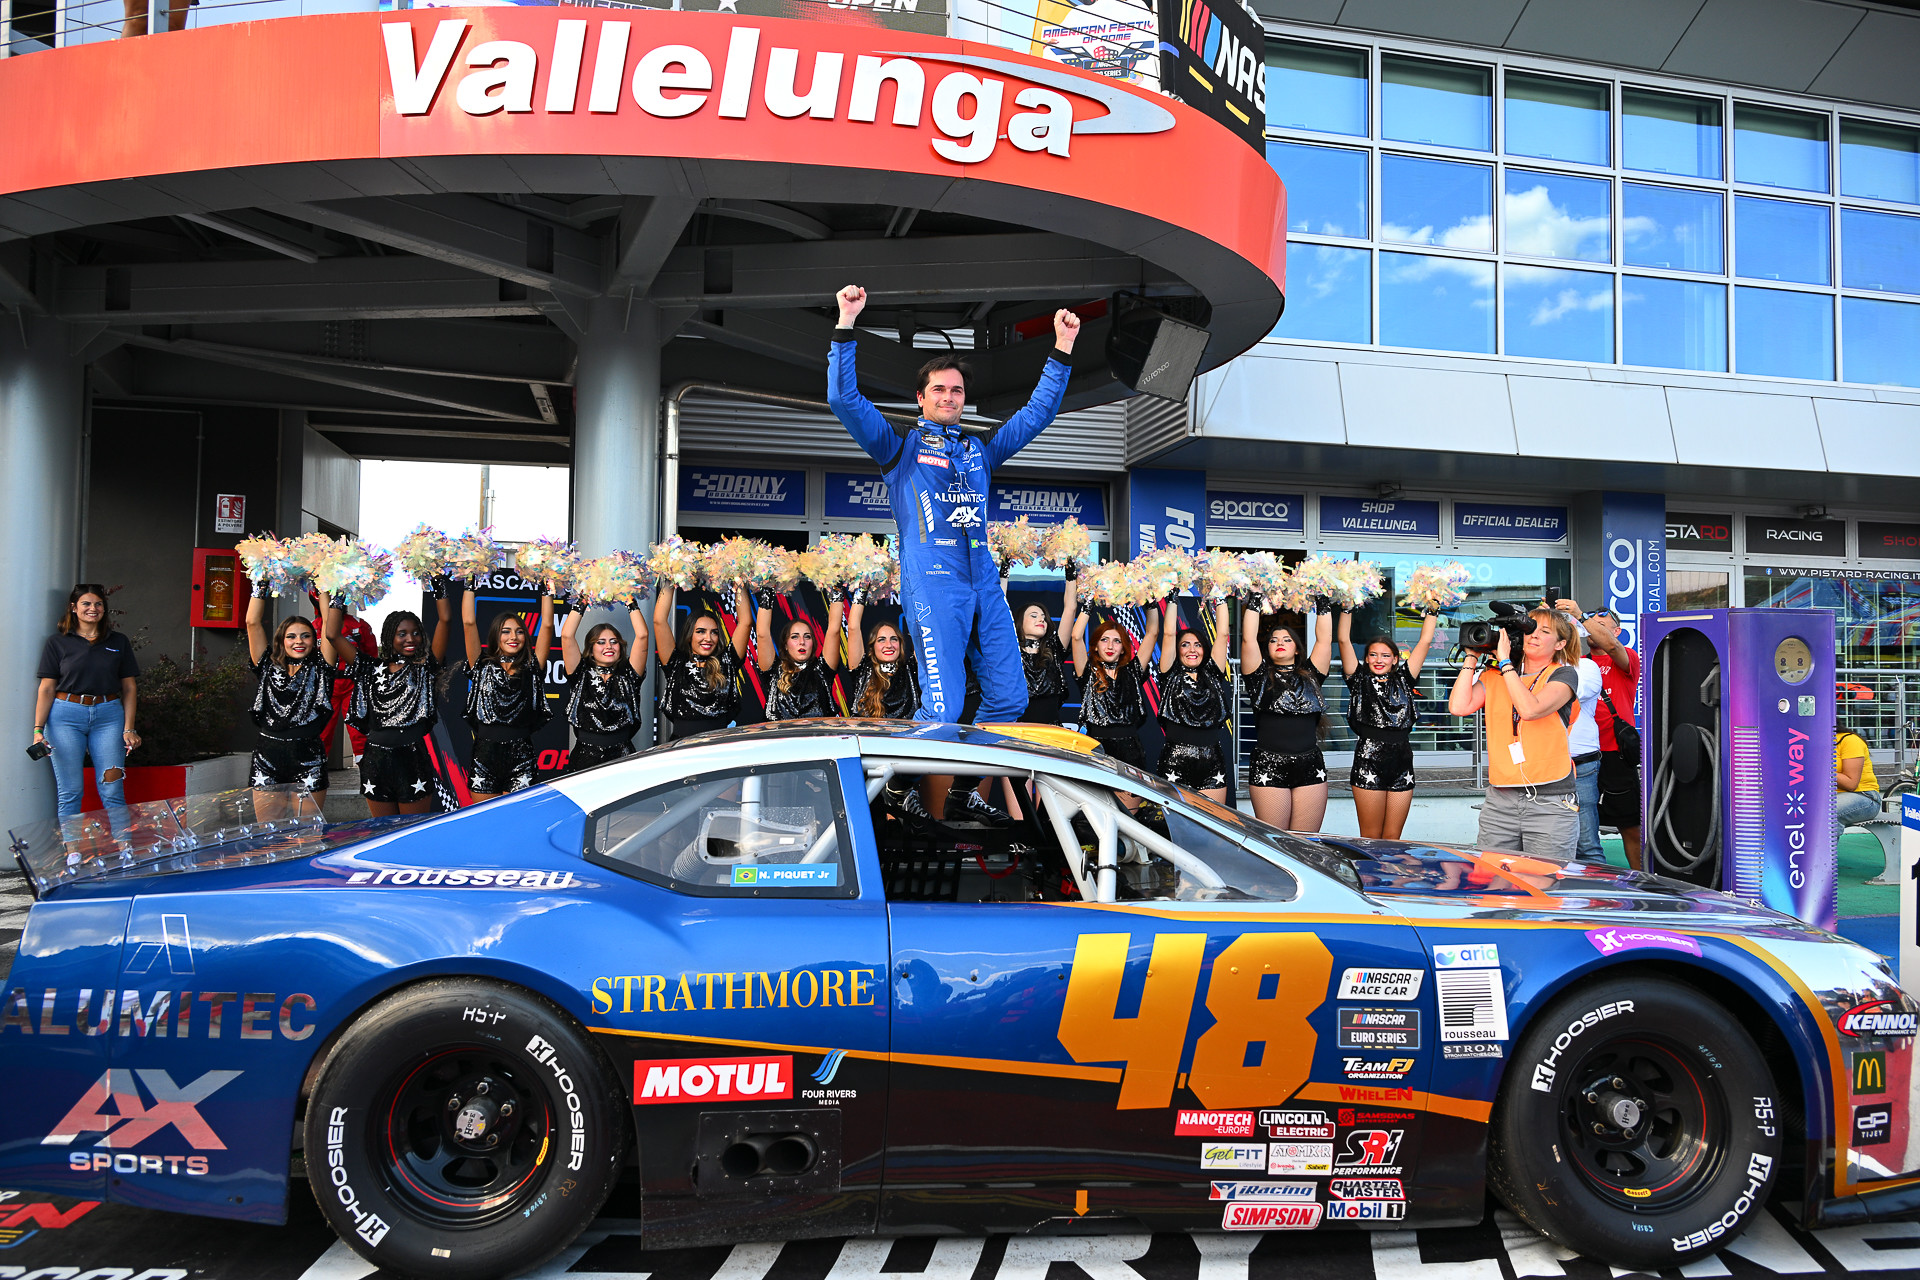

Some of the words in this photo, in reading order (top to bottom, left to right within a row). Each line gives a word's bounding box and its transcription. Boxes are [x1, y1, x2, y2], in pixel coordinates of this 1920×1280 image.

[1043, 25, 1106, 38] AMERICAN
[382, 18, 1074, 163] Vallelunga
[920, 456, 947, 467] MOTUL
[716, 475, 785, 493] DANY
[1020, 490, 1080, 508] DANY
[1210, 500, 1288, 520] sparco
[1361, 502, 1395, 513] SHOP
[1342, 517, 1417, 531] VALLELUNGA
[1462, 514, 1513, 527] OFFICIAL
[1515, 516, 1559, 528] DEALER
[1766, 529, 1823, 541] RACING
[1883, 535, 1920, 546] SHO
[1779, 568, 1920, 579] WWW.PISTARD-RACING.IT
[920, 626, 946, 713] ALUMITEC
[1788, 727, 1809, 786] way
[1785, 822, 1805, 889] enel
[373, 868, 574, 889] rousseau
[759, 871, 770, 879] N.
[773, 871, 815, 879] PIQUET
[817, 871, 830, 879] Jr
[1618, 933, 1693, 948] HOOSIER
[1460, 946, 1498, 961] aria
[1366, 972, 1412, 984] NASCAR
[591, 968, 875, 1014] STRATHMORE
[1350, 985, 1381, 995] RACE
[1384, 986, 1408, 995] CAR
[0, 987, 318, 1041] ALUMITEC
[1057, 932, 1334, 1110] 48
[1365, 1014, 1406, 1025] NASCAR
[1844, 1014, 1917, 1030] KENNOL
[1350, 1031, 1375, 1043] EURO
[1376, 1032, 1407, 1044] SERIES
[1444, 1030, 1496, 1039] rousseau
[1544, 999, 1635, 1067] HOOSIER
[1443, 1044, 1501, 1053] STROM
[641, 1063, 786, 1098] MOTUL
[802, 1090, 825, 1098] FOUR
[826, 1090, 857, 1098] RIVERS
[40, 1068, 245, 1150] AX
[545, 1056, 585, 1171] HOOSIER
[1357, 1112, 1416, 1120] SAMSONAS
[1180, 1113, 1251, 1125] NANOTECH
[1263, 1113, 1322, 1125] LINCOLN
[1276, 1127, 1329, 1136] ELECTRIC
[1861, 1130, 1883, 1138] TIJEY
[1335, 1130, 1404, 1166] SRI
[69, 1152, 209, 1175] SPORTS
[327, 1106, 367, 1224] HOOSIER
[1332, 1167, 1402, 1175] PERFORMANCE
[1238, 1182, 1314, 1197] iRacing
[1331, 1180, 1399, 1191] QUARTER
[1342, 1187, 1401, 1197] MASTER
[1230, 1207, 1314, 1226] SIMPSON
[1329, 1202, 1382, 1218] Mobil
[1390, 1203, 1398, 1217] 1
[1671, 1177, 1767, 1252] HOOSIER
